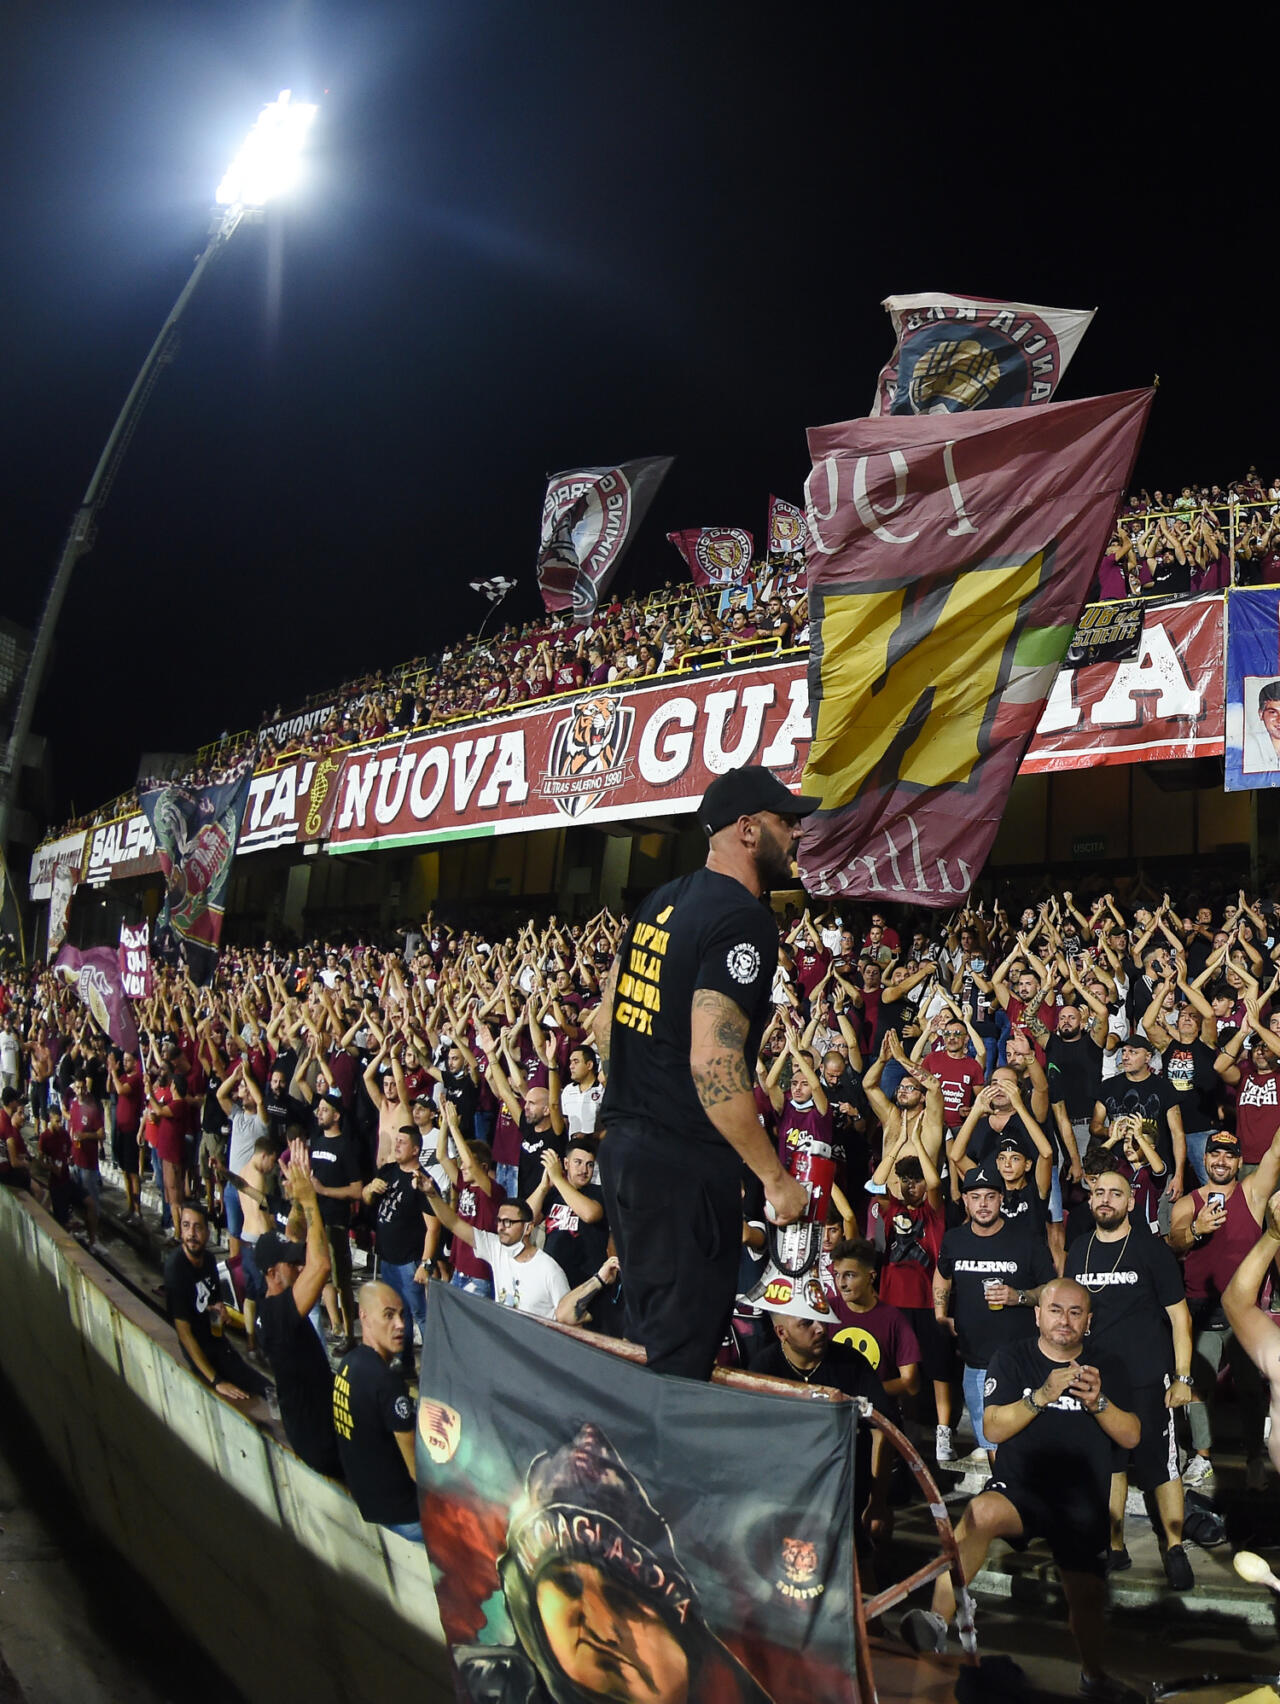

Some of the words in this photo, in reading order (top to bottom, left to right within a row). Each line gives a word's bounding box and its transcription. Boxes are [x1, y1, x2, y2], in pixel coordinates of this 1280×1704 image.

[699, 536, 719, 577] VIKING
[338, 729, 528, 829] NUOVA
[543, 781, 570, 794] ULTRAS
[570, 777, 602, 792] SALERNO
[604, 771, 622, 787] 1990
[955, 1260, 1018, 1275] SALERNO
[764, 1283, 792, 1301] NG
